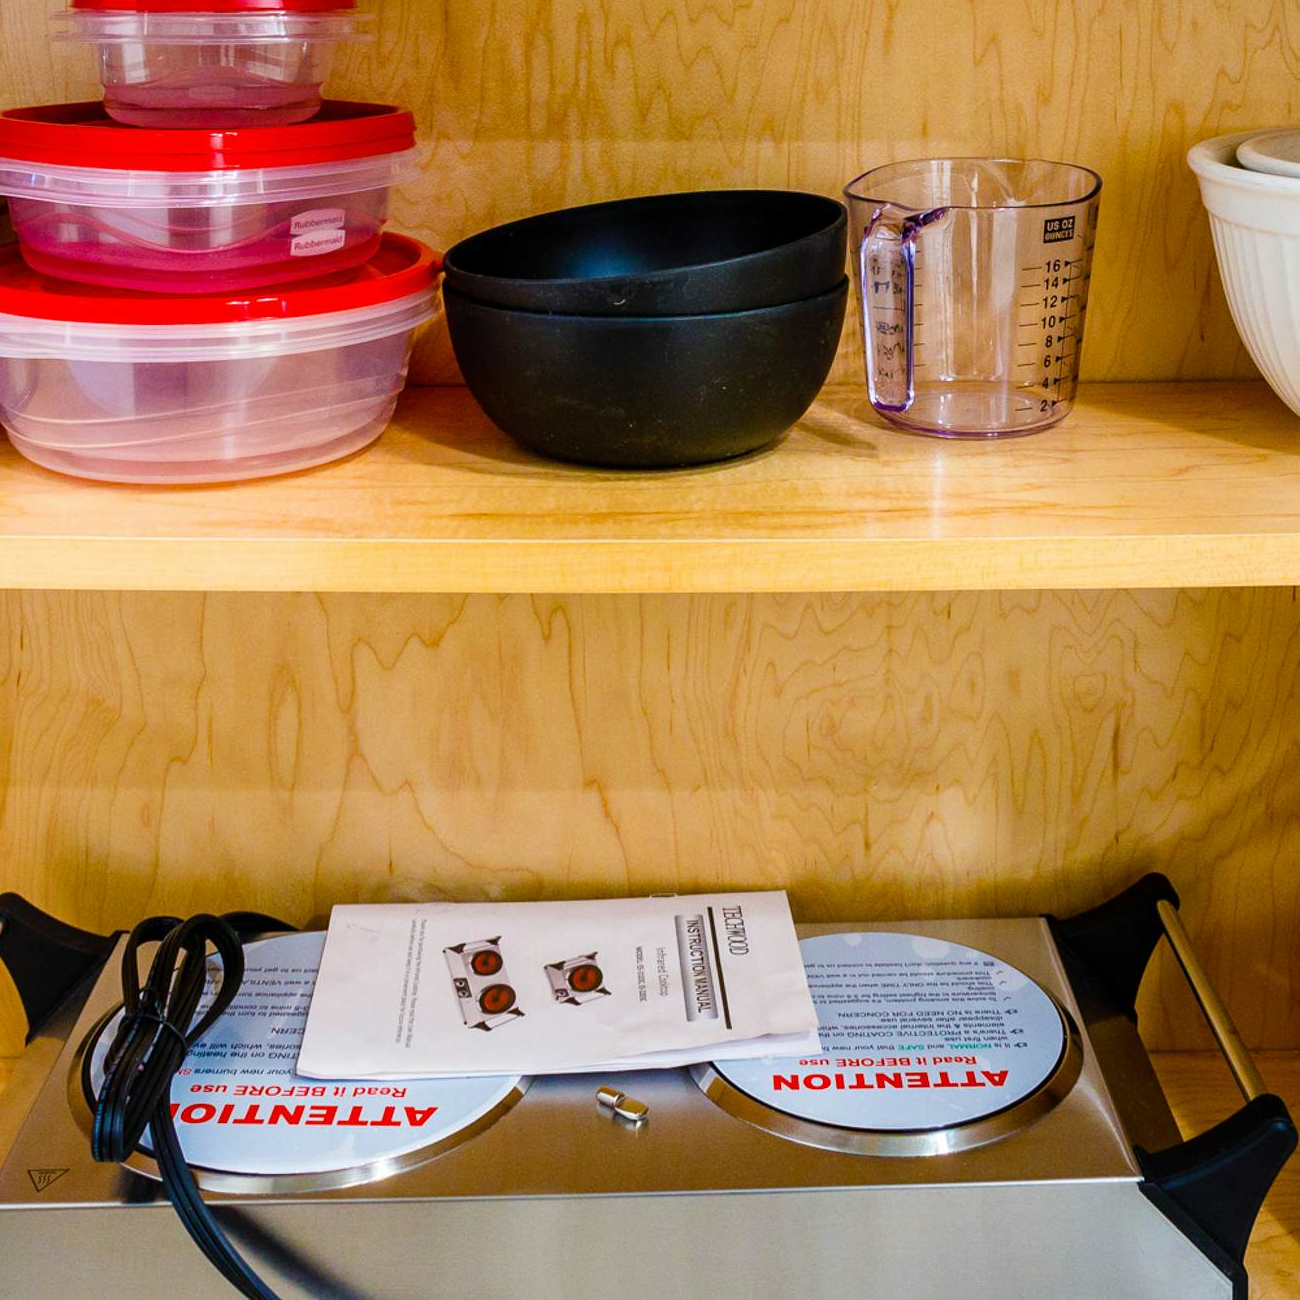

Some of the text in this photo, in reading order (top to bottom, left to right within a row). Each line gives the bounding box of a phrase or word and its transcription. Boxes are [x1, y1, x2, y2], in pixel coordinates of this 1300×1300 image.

[294, 216, 343, 229] Rubbermaid
[1047, 219, 1074, 231] US OZ
[1045, 229, 1074, 241] OUNCES
[294, 235, 343, 250] Rubbermaid
[1045, 260, 1060, 273] 16
[1044, 277, 1059, 290] 14
[1043, 295, 1057, 309] 12
[1041, 315, 1056, 329] 10
[1046, 335, 1053, 348] 8
[1044, 355, 1051, 368] 6
[1042, 377, 1049, 389] 4
[1040, 399, 1047, 412] 2
[722, 906, 748, 956] TECHWOOD
[685, 920, 710, 1013] INSTRUCTION MANUAL
[268, 1052, 297, 1060] TING
[799, 1056, 977, 1068] Read it BEFORE use
[194, 1068, 237, 1076] burners
[771, 1070, 1008, 1090] ATTENTION
[190, 1084, 407, 1098] Read it BEFORE use
[170, 1103, 438, 1127] ATTENTIO
